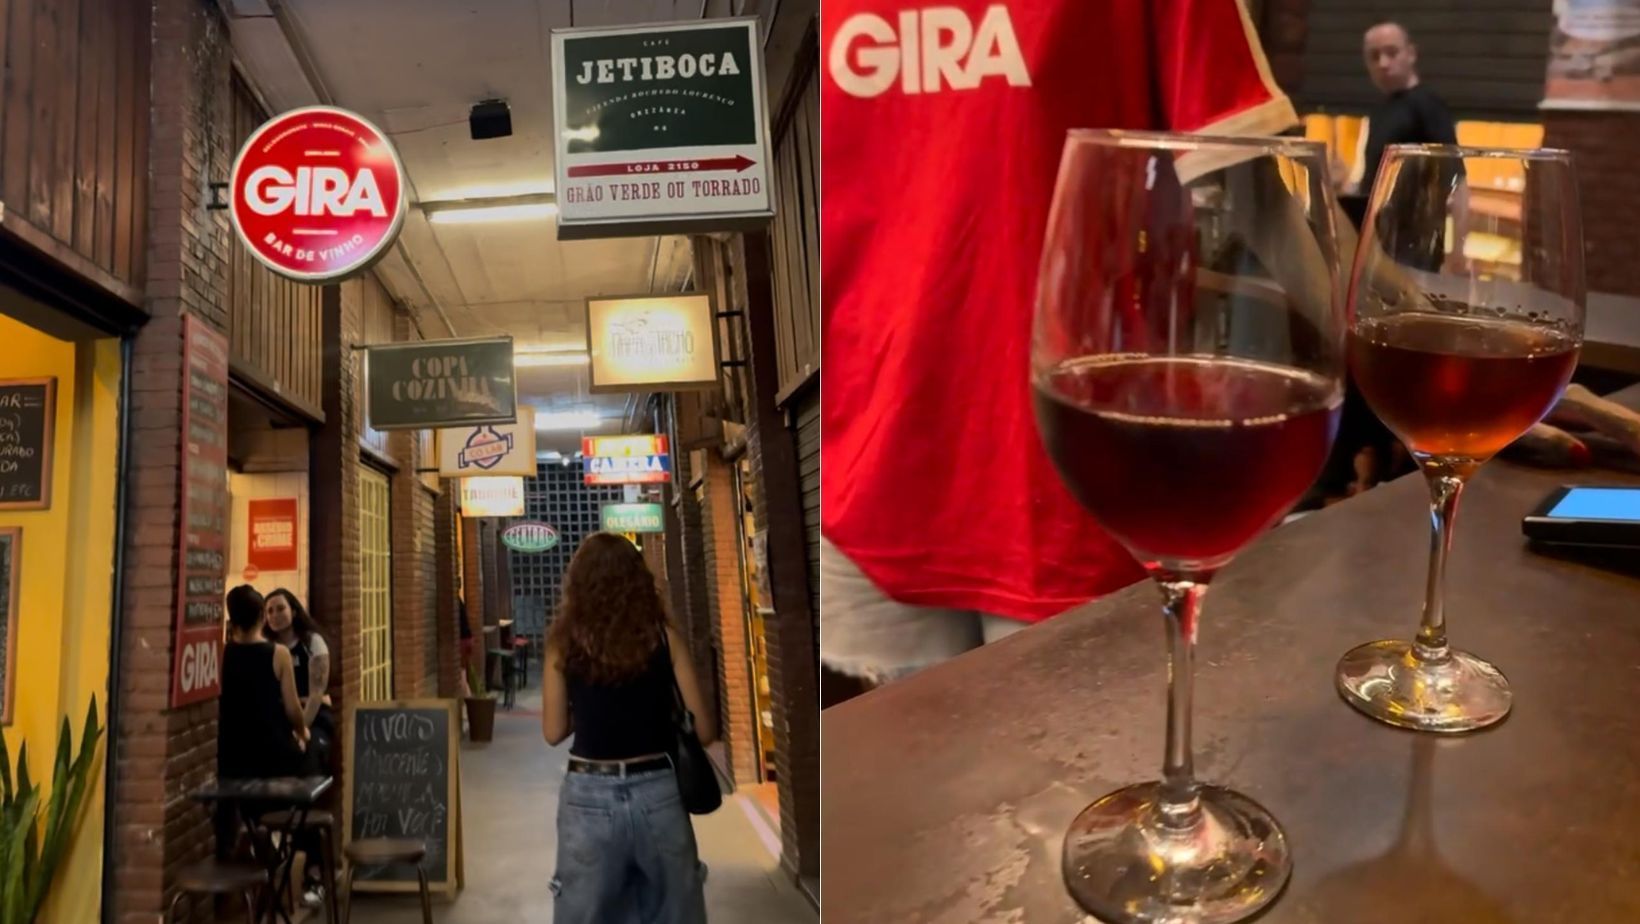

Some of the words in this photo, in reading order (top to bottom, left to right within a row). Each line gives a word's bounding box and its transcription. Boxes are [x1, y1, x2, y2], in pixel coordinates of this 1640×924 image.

[829, 4, 1033, 98] GIRA
[576, 52, 740, 85] JETIBOCA
[627, 162, 660, 172] LOJA
[667, 161, 700, 171] 2150
[244, 165, 388, 217] GIRA
[567, 184, 604, 203] GRÃO
[610, 182, 661, 201] VERDE
[668, 181, 685, 199] OU
[692, 178, 761, 197] TORRADO
[263, 232, 292, 257] BAR
[295, 247, 315, 261] DE
[319, 234, 364, 261] VINHO
[181, 640, 219, 693] GIRA
